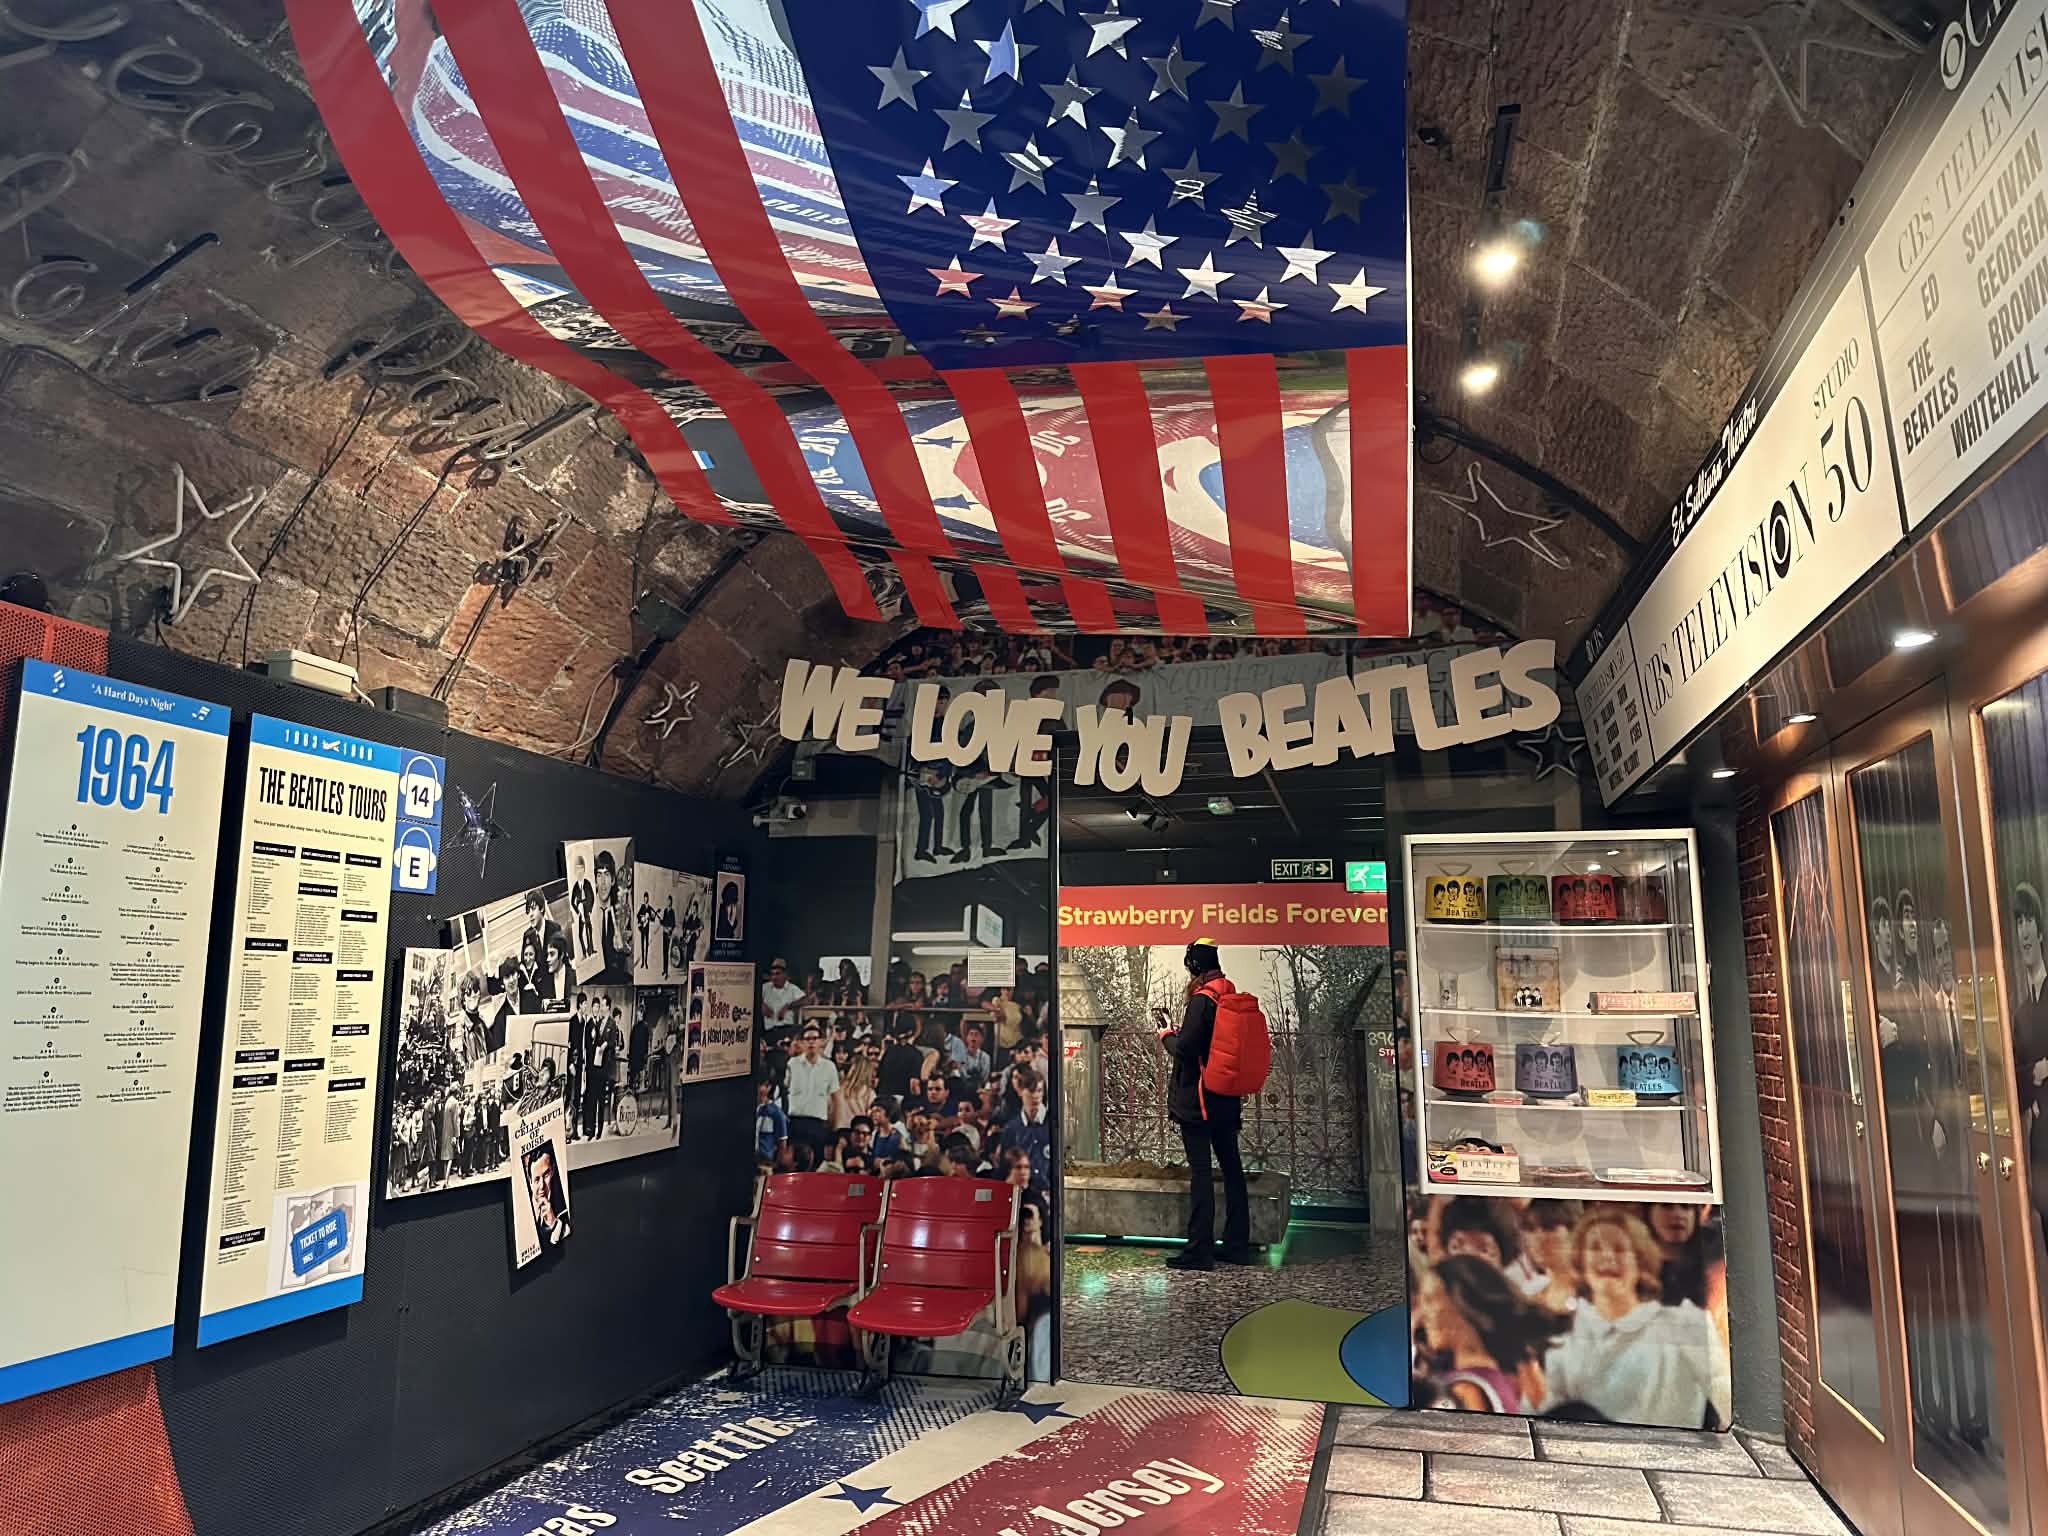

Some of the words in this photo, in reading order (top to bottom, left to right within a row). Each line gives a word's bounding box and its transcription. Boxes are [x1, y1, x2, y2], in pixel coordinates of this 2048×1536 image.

[1898, 198, 1935, 273] CBS
[1920, 272, 1939, 321] ED
[1962, 128, 2043, 264] SULLIVAN
[1813, 338, 1859, 419] STUDIO
[1907, 336, 1935, 394] THE
[1902, 366, 1959, 455] BEATLES
[1950, 341, 2040, 460] WHITEHALL
[1671, 500, 1686, 548] Ed
[1684, 458, 1722, 525] Sullivan
[1720, 398, 1758, 466] Theatre
[1643, 642, 1674, 717] CBS
[1672, 462, 1816, 686] TELEVISION
[1820, 396, 1873, 523] 50
[104, 686, 127, 701] Hard
[128, 694, 148, 707] Days
[780, 658, 895, 752] WE
[910, 683, 1065, 777] LOVE
[1073, 703, 1193, 797] YOU
[1218, 639, 1561, 778] BEATLES
[76, 724, 176, 815] 1964
[259, 766, 286, 806] THE
[288, 772, 345, 816] BEATLES
[348, 784, 387, 823] TOURS
[411, 784, 430, 808] 14
[409, 856, 421, 878] E
[1274, 863, 1300, 876] EXIT
[1058, 904, 1195, 929] Strawberry
[1201, 903, 1279, 925] Fields
[1286, 903, 1388, 925] Forever
[514, 1107, 563, 1140] CELLARFUL
[519, 1118, 527, 1129] A
[521, 1135, 545, 1155] NOISE
[529, 1127, 541, 1140] OF
[300, 1230, 318, 1249] TICKET
[318, 1226, 325, 1239] TO
[325, 1219, 338, 1235] RIDE
[624, 1415, 797, 1494] Seattle
[1028, 1456, 1225, 1536] Jersey
